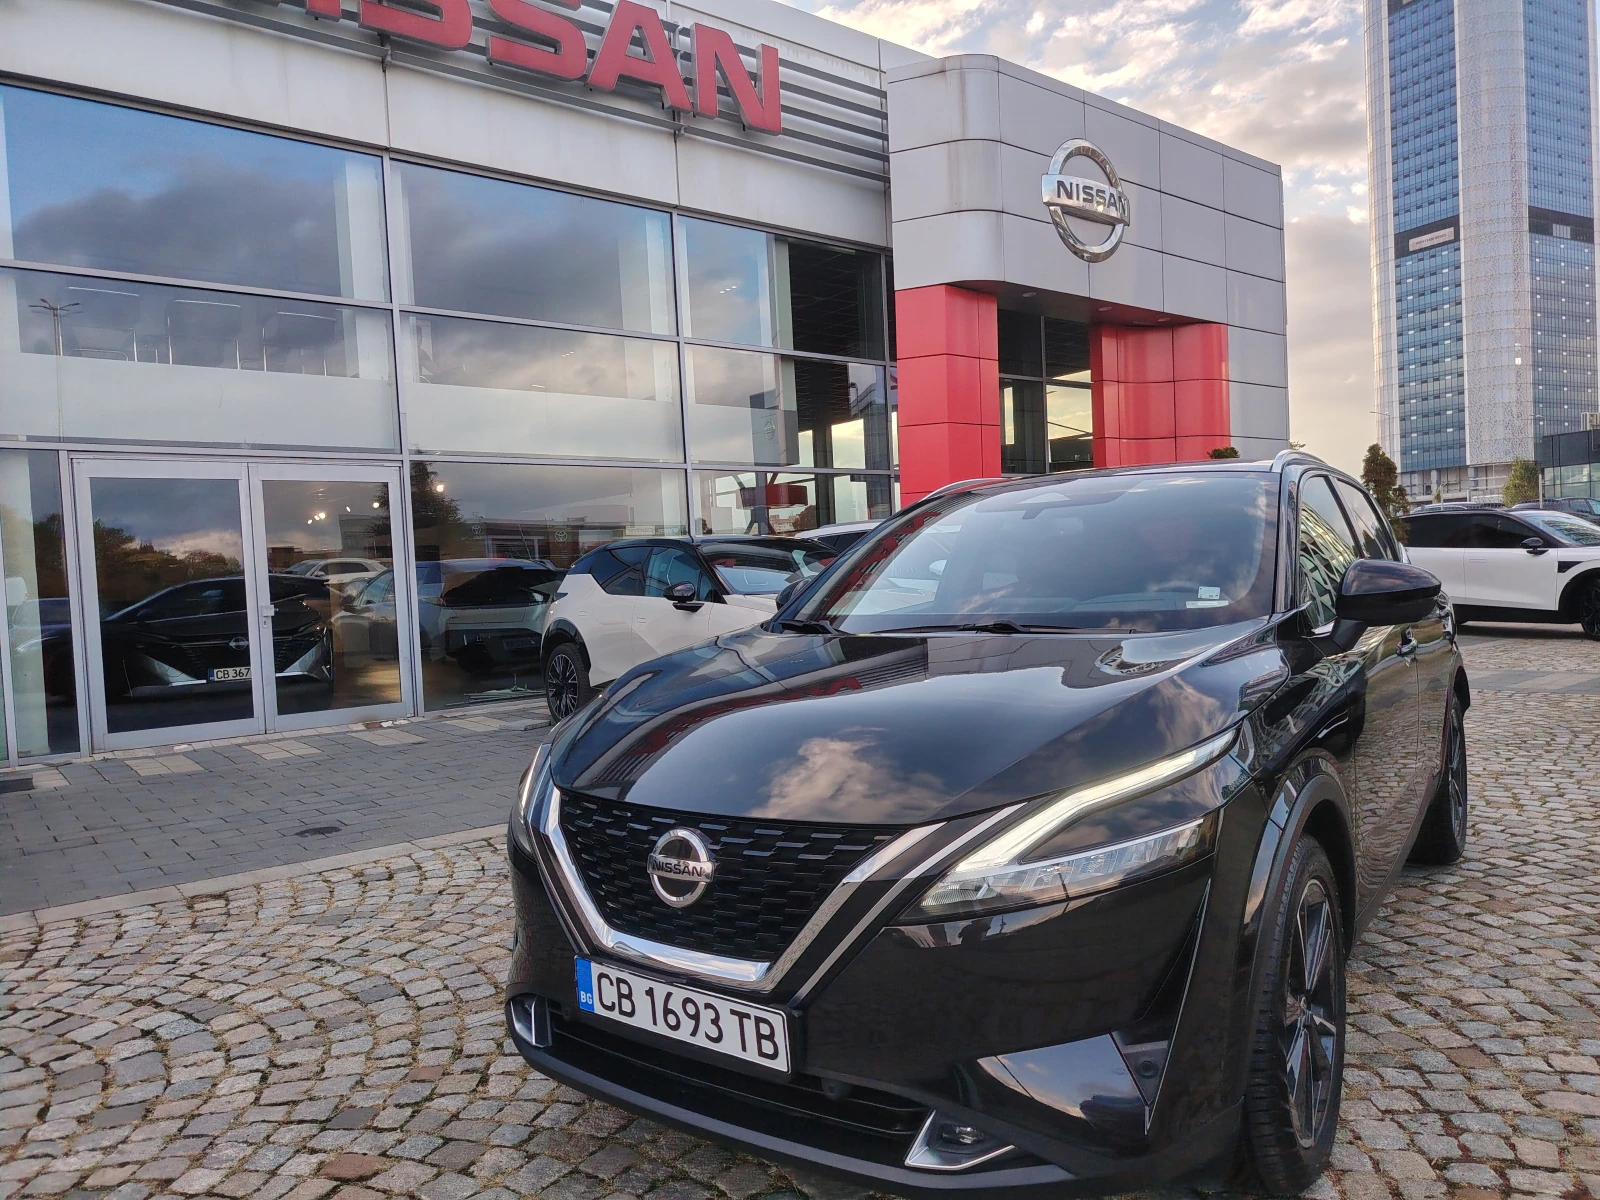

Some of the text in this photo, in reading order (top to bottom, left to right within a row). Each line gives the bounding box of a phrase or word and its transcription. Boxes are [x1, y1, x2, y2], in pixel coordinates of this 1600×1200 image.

[1056, 180, 1127, 216] NISSAN
[215, 669, 230, 680] CB
[652, 860, 703, 878] NISSAN
[580, 990, 593, 1004] BG
[597, 971, 780, 1061] CB 1693 TB
